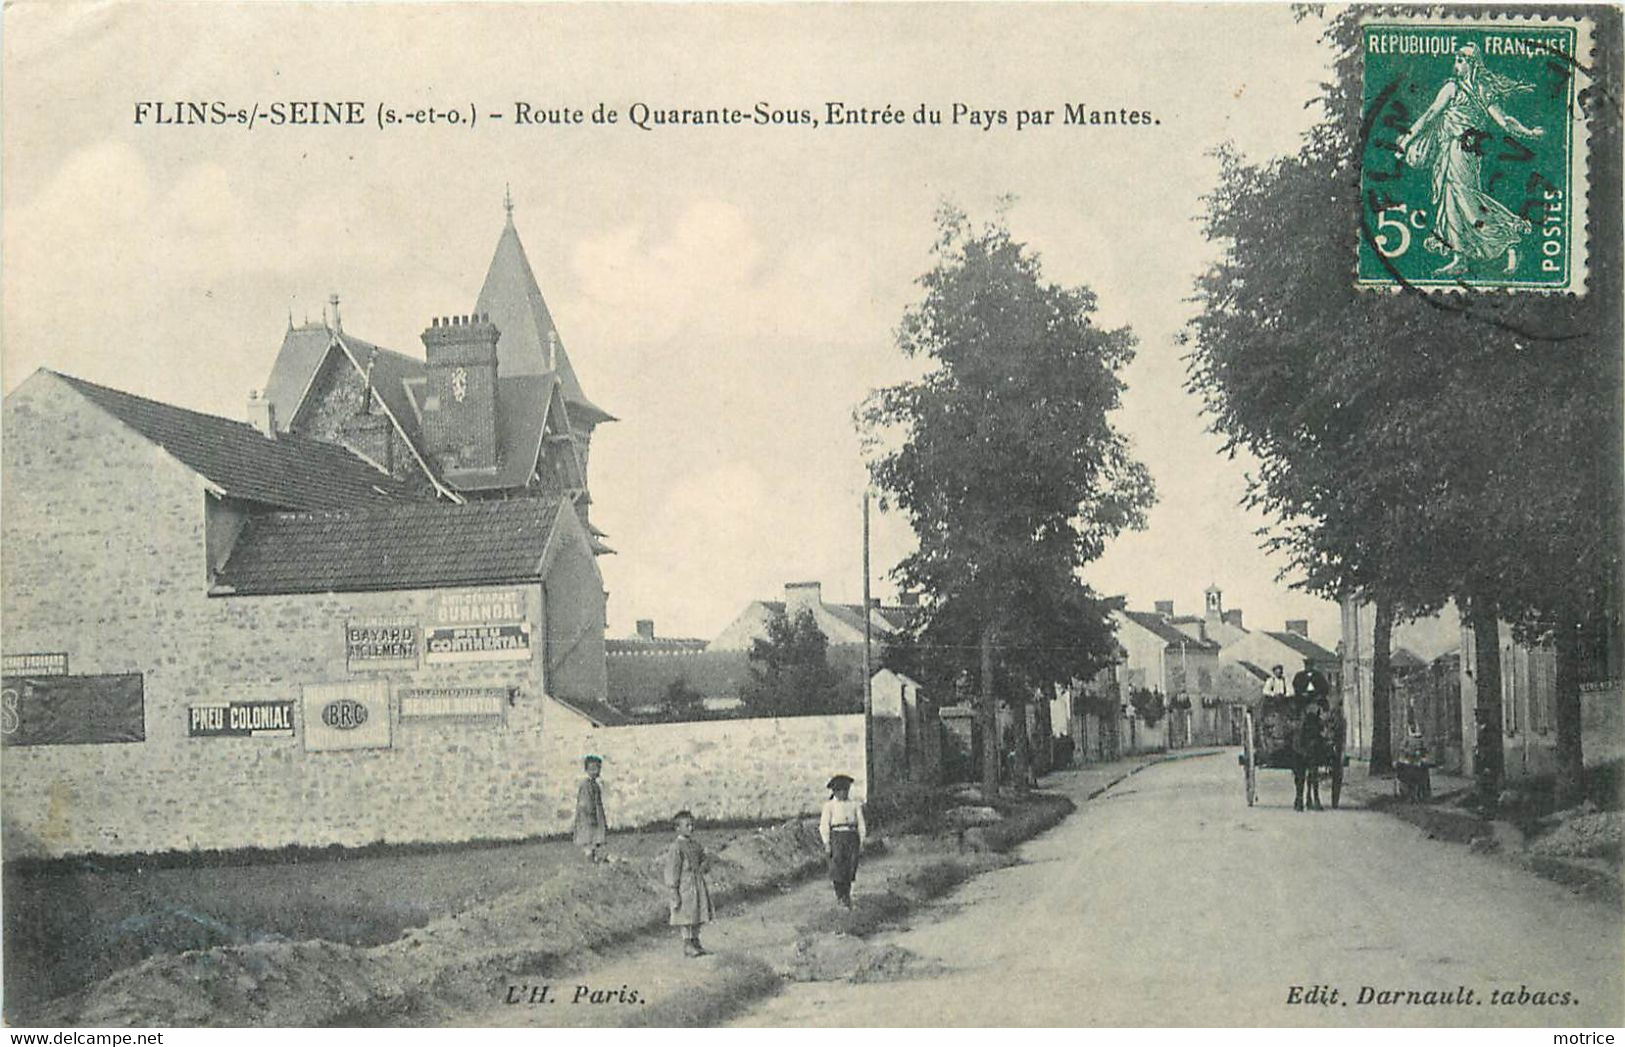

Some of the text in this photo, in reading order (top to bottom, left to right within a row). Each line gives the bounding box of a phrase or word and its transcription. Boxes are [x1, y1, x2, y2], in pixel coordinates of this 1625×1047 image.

[1542, 190, 1563, 272] POSTES
[350, 628, 412, 642] BAYARD
[191, 705, 291, 731] PNEU COLONIAL
[329, 703, 366, 726] BRC
